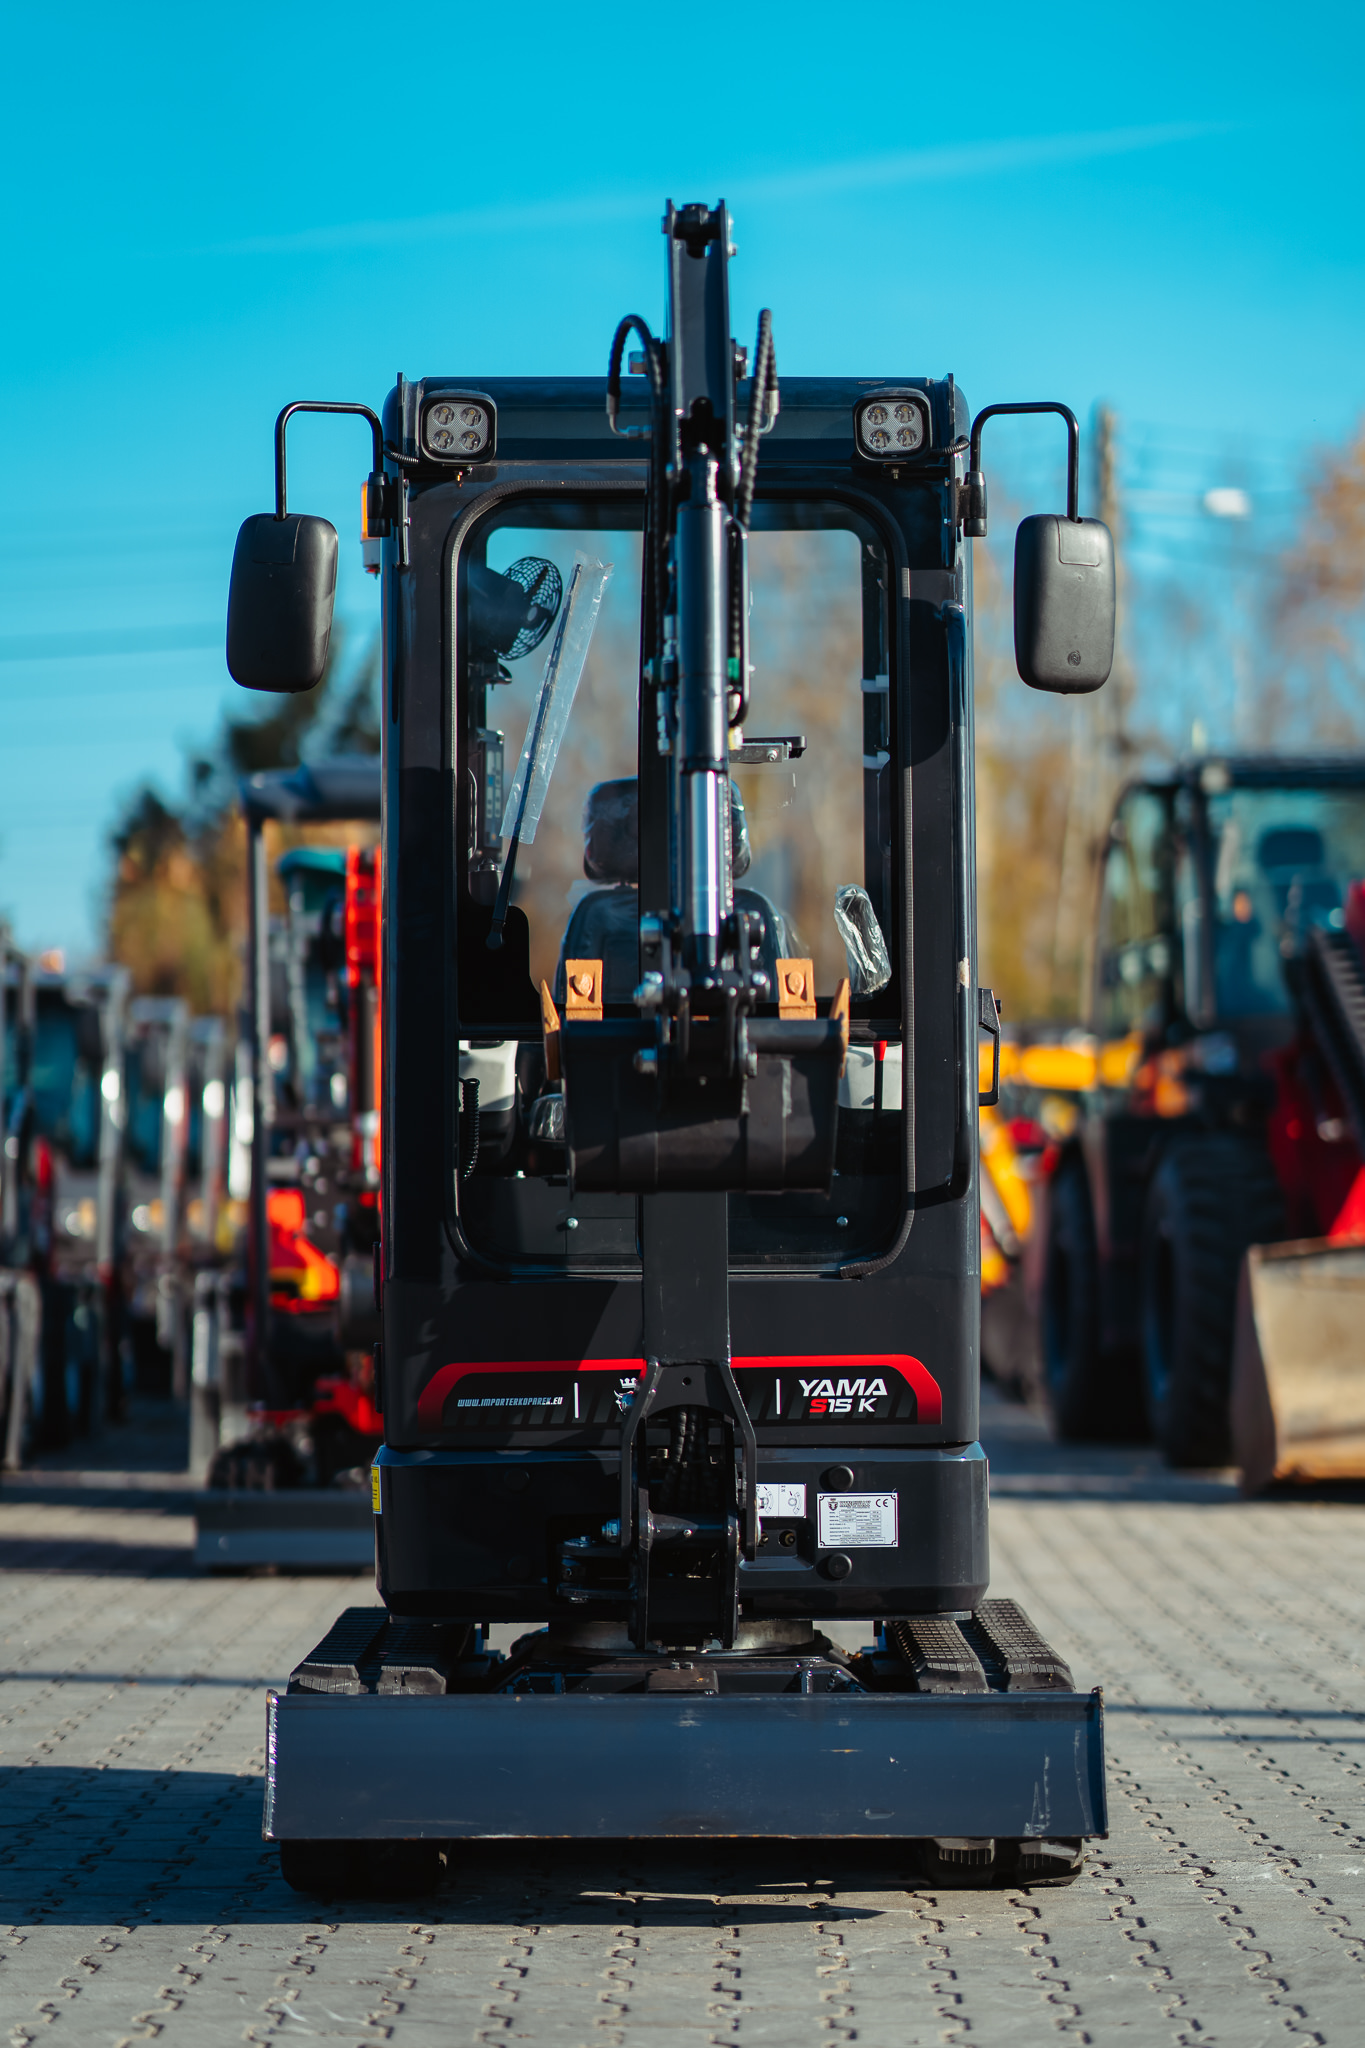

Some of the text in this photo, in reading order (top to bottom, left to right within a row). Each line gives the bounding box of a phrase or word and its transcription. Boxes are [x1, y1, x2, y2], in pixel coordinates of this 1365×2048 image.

[799, 1378, 888, 1397] YAMA
[809, 1398, 877, 1413] S15 K
